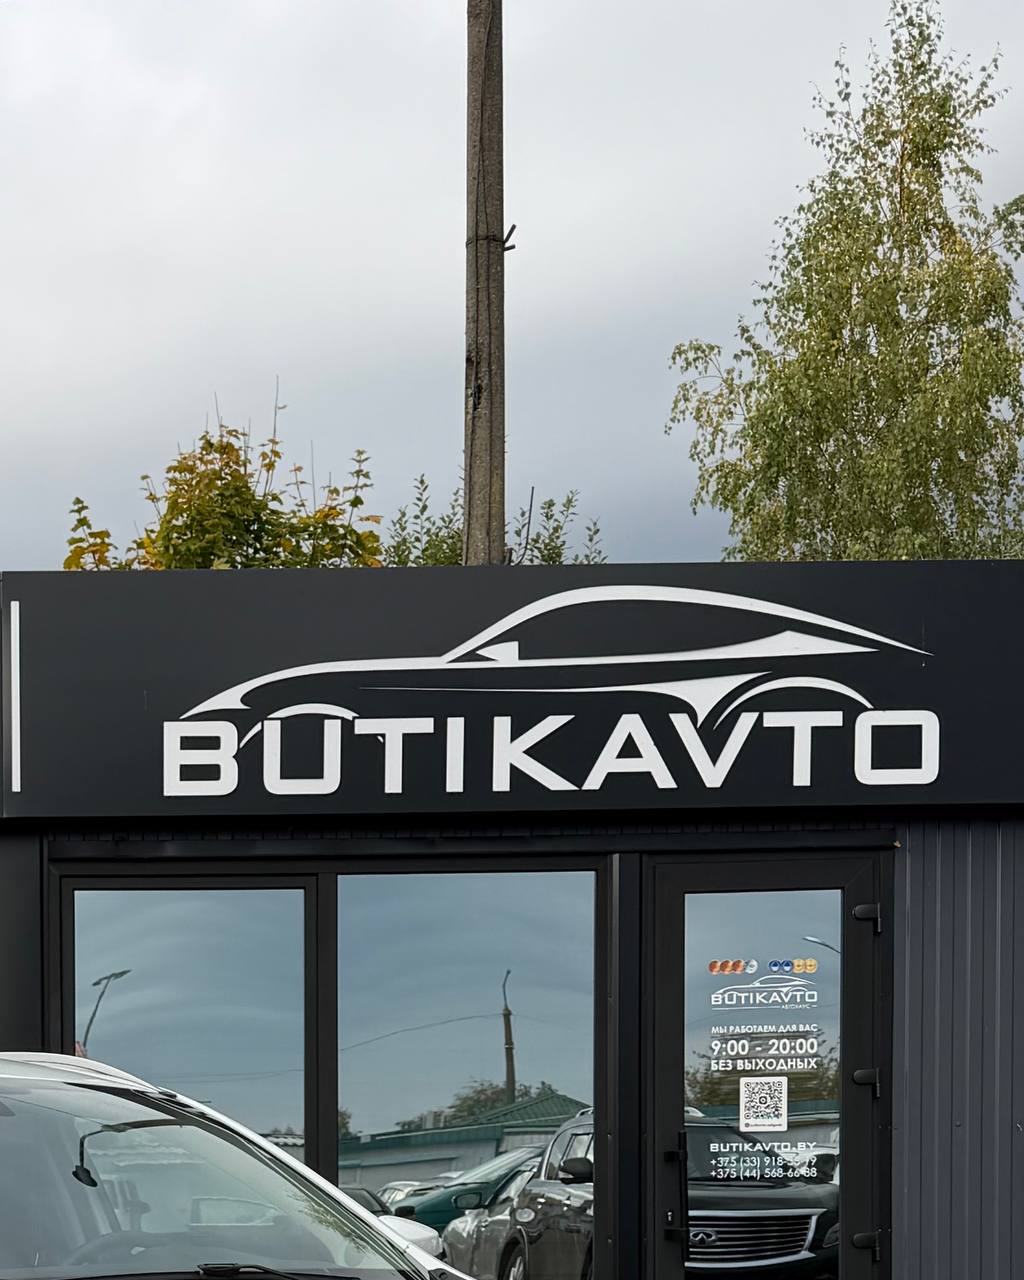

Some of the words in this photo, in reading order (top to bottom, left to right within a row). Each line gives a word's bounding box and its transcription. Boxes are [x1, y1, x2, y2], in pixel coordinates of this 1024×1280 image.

[162, 708, 941, 797] BUTIKAVTO
[710, 990, 818, 1005] BUTIKAVTO
[711, 1026, 727, 1034] МЫ
[729, 1025, 776, 1033] РАБОТАЕМ
[778, 1024, 797, 1033] ДЛЯ
[798, 1024, 818, 1032] ВАС
[711, 1039, 749, 1056] 9:00
[767, 1038, 818, 1055] 20:00
[711, 1060, 733, 1071] БЕЗ
[736, 1058, 818, 1071] ВЫХОДНЫХ
[709, 1142, 817, 1152] BUTIKAVTO.BY
[710, 1157, 737, 1167] +375
[740, 1156, 761, 1169] (33)
[710, 1168, 737, 1179] +375
[740, 1168, 761, 1180] (44)
